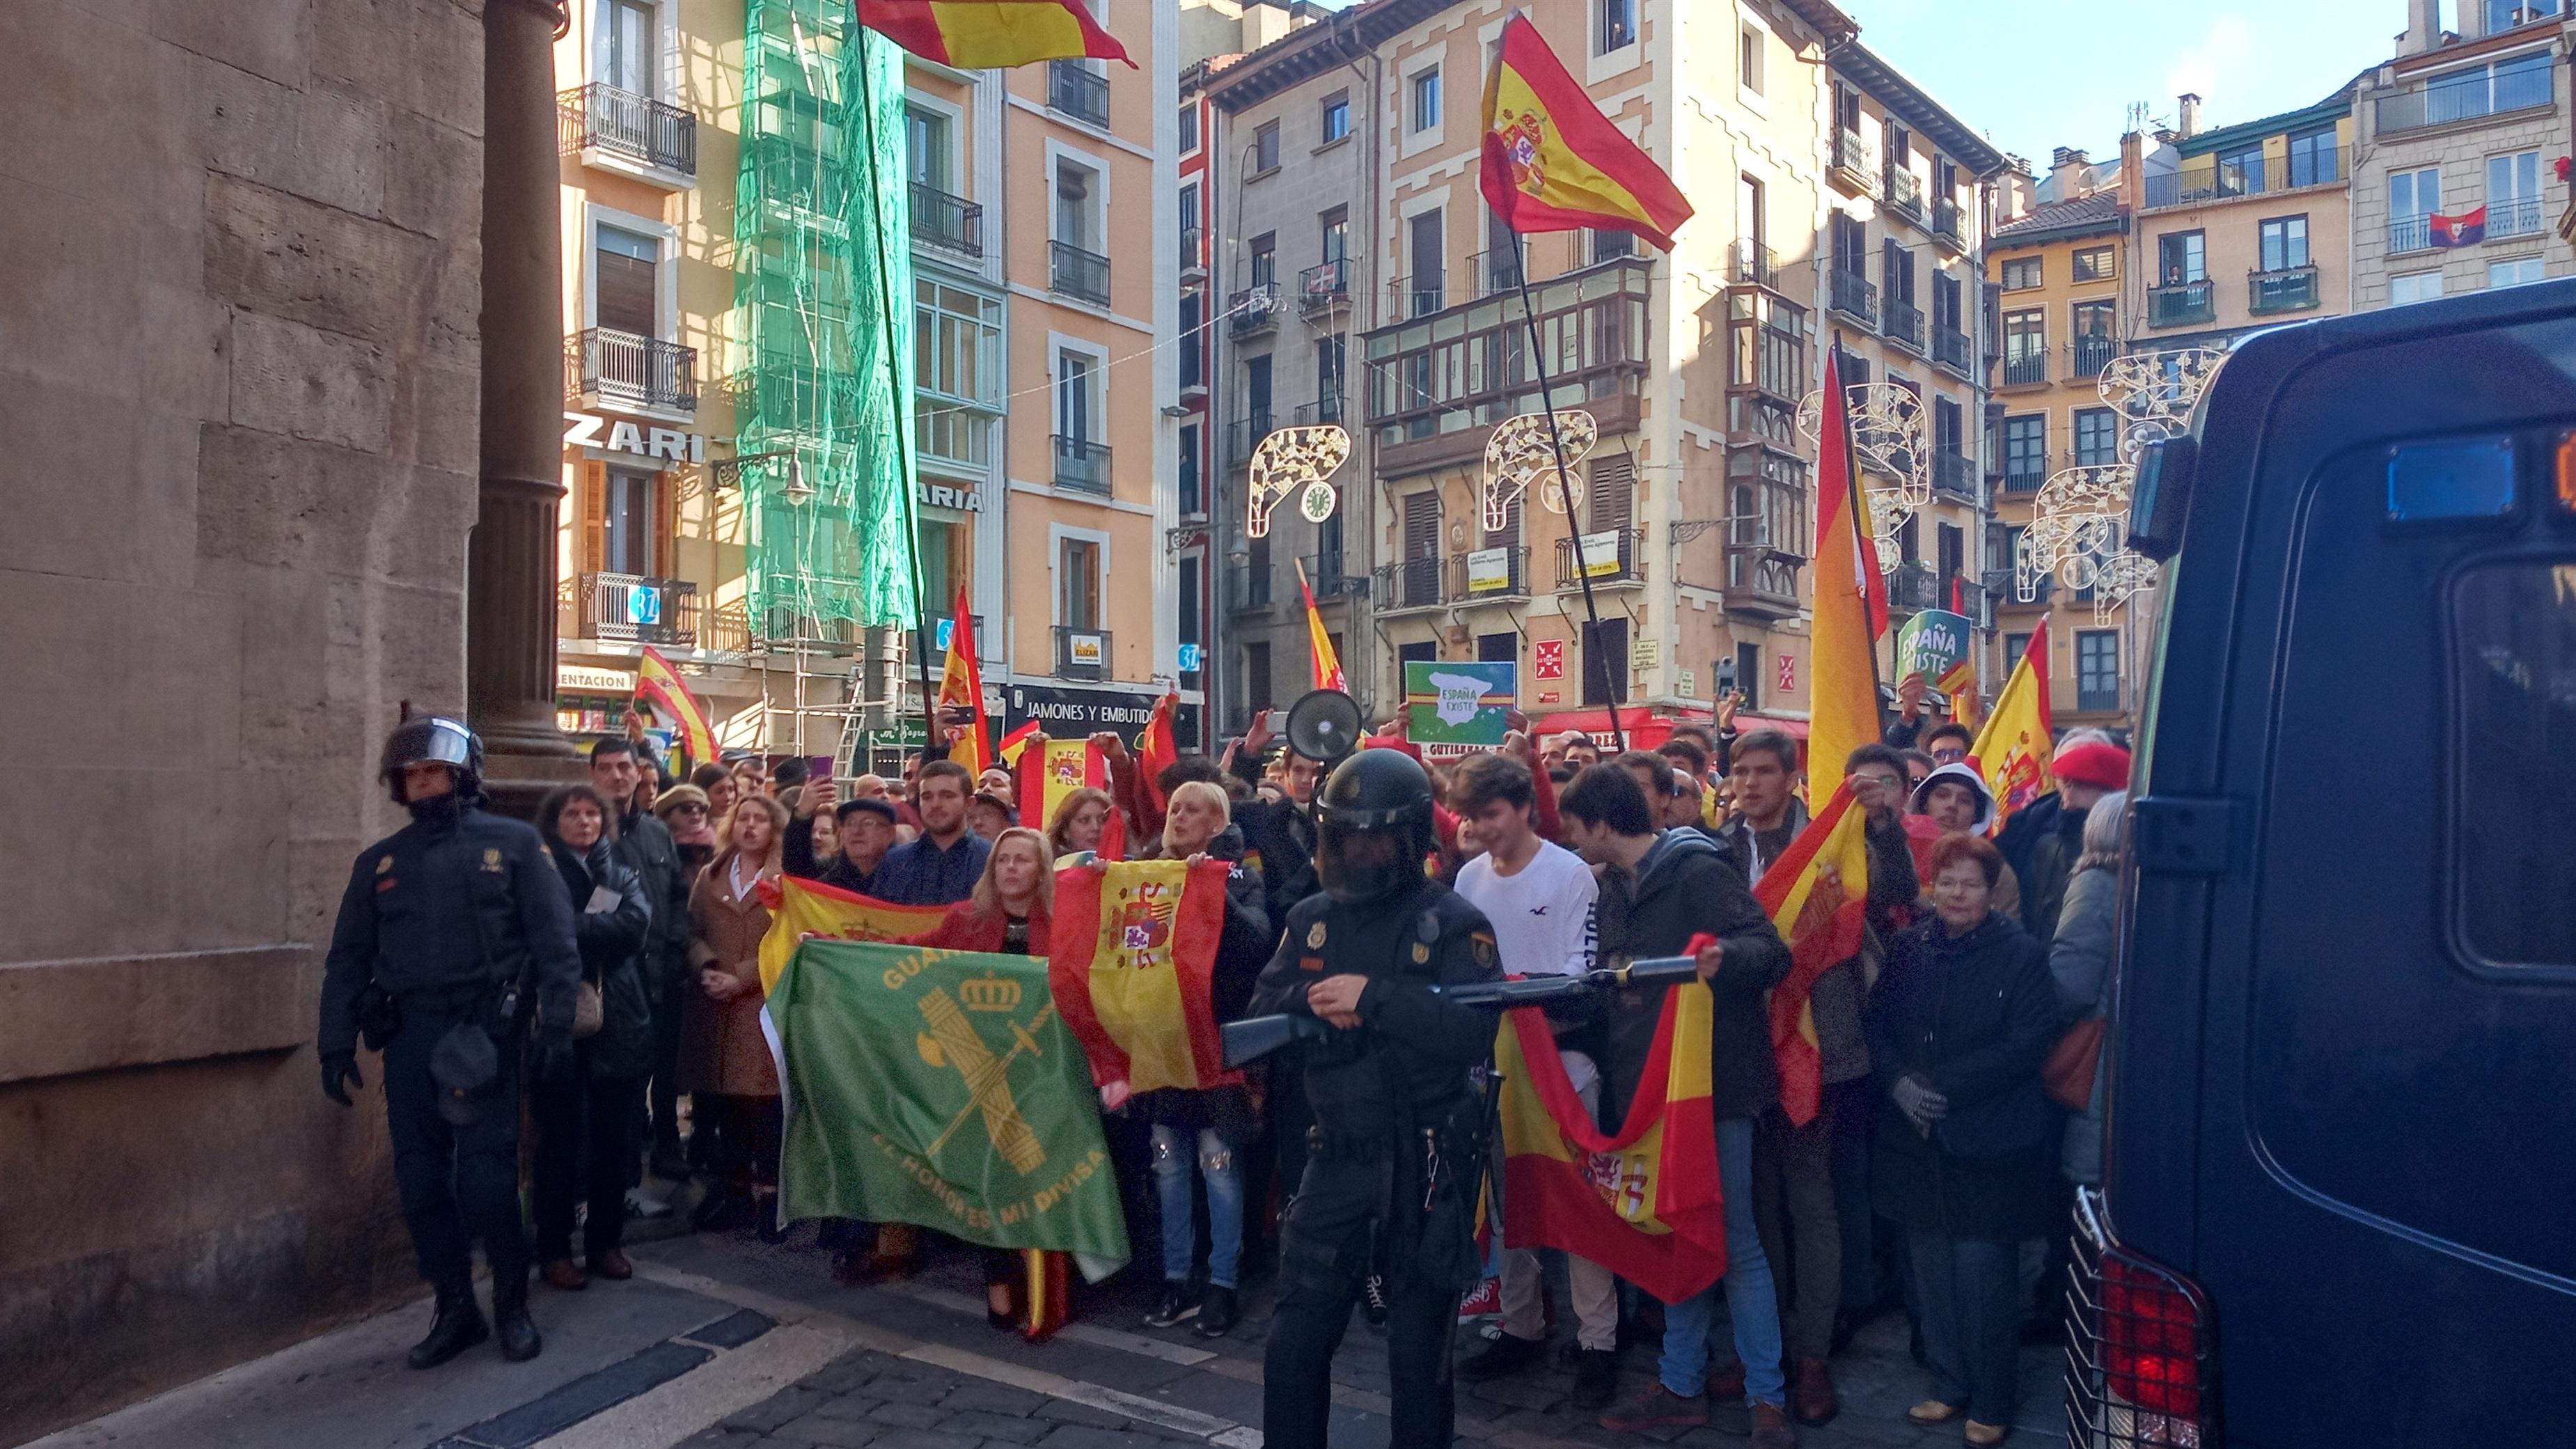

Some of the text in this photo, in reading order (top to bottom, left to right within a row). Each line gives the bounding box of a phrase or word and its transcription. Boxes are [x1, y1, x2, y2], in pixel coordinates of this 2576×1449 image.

[1183, 650, 1199, 671] 31
[1906, 652, 1949, 675] ISTE
[1442, 687, 1477, 700] ESPAÑA
[1026, 701, 1084, 721] JAMONES
[1088, 705, 1097, 721] Y
[1446, 701, 1473, 712] EXISTE
[901, 725, 927, 739] Sagra
[1595, 735, 1618, 747] REZ
[1033, 1150, 1106, 1212] DIVISA
